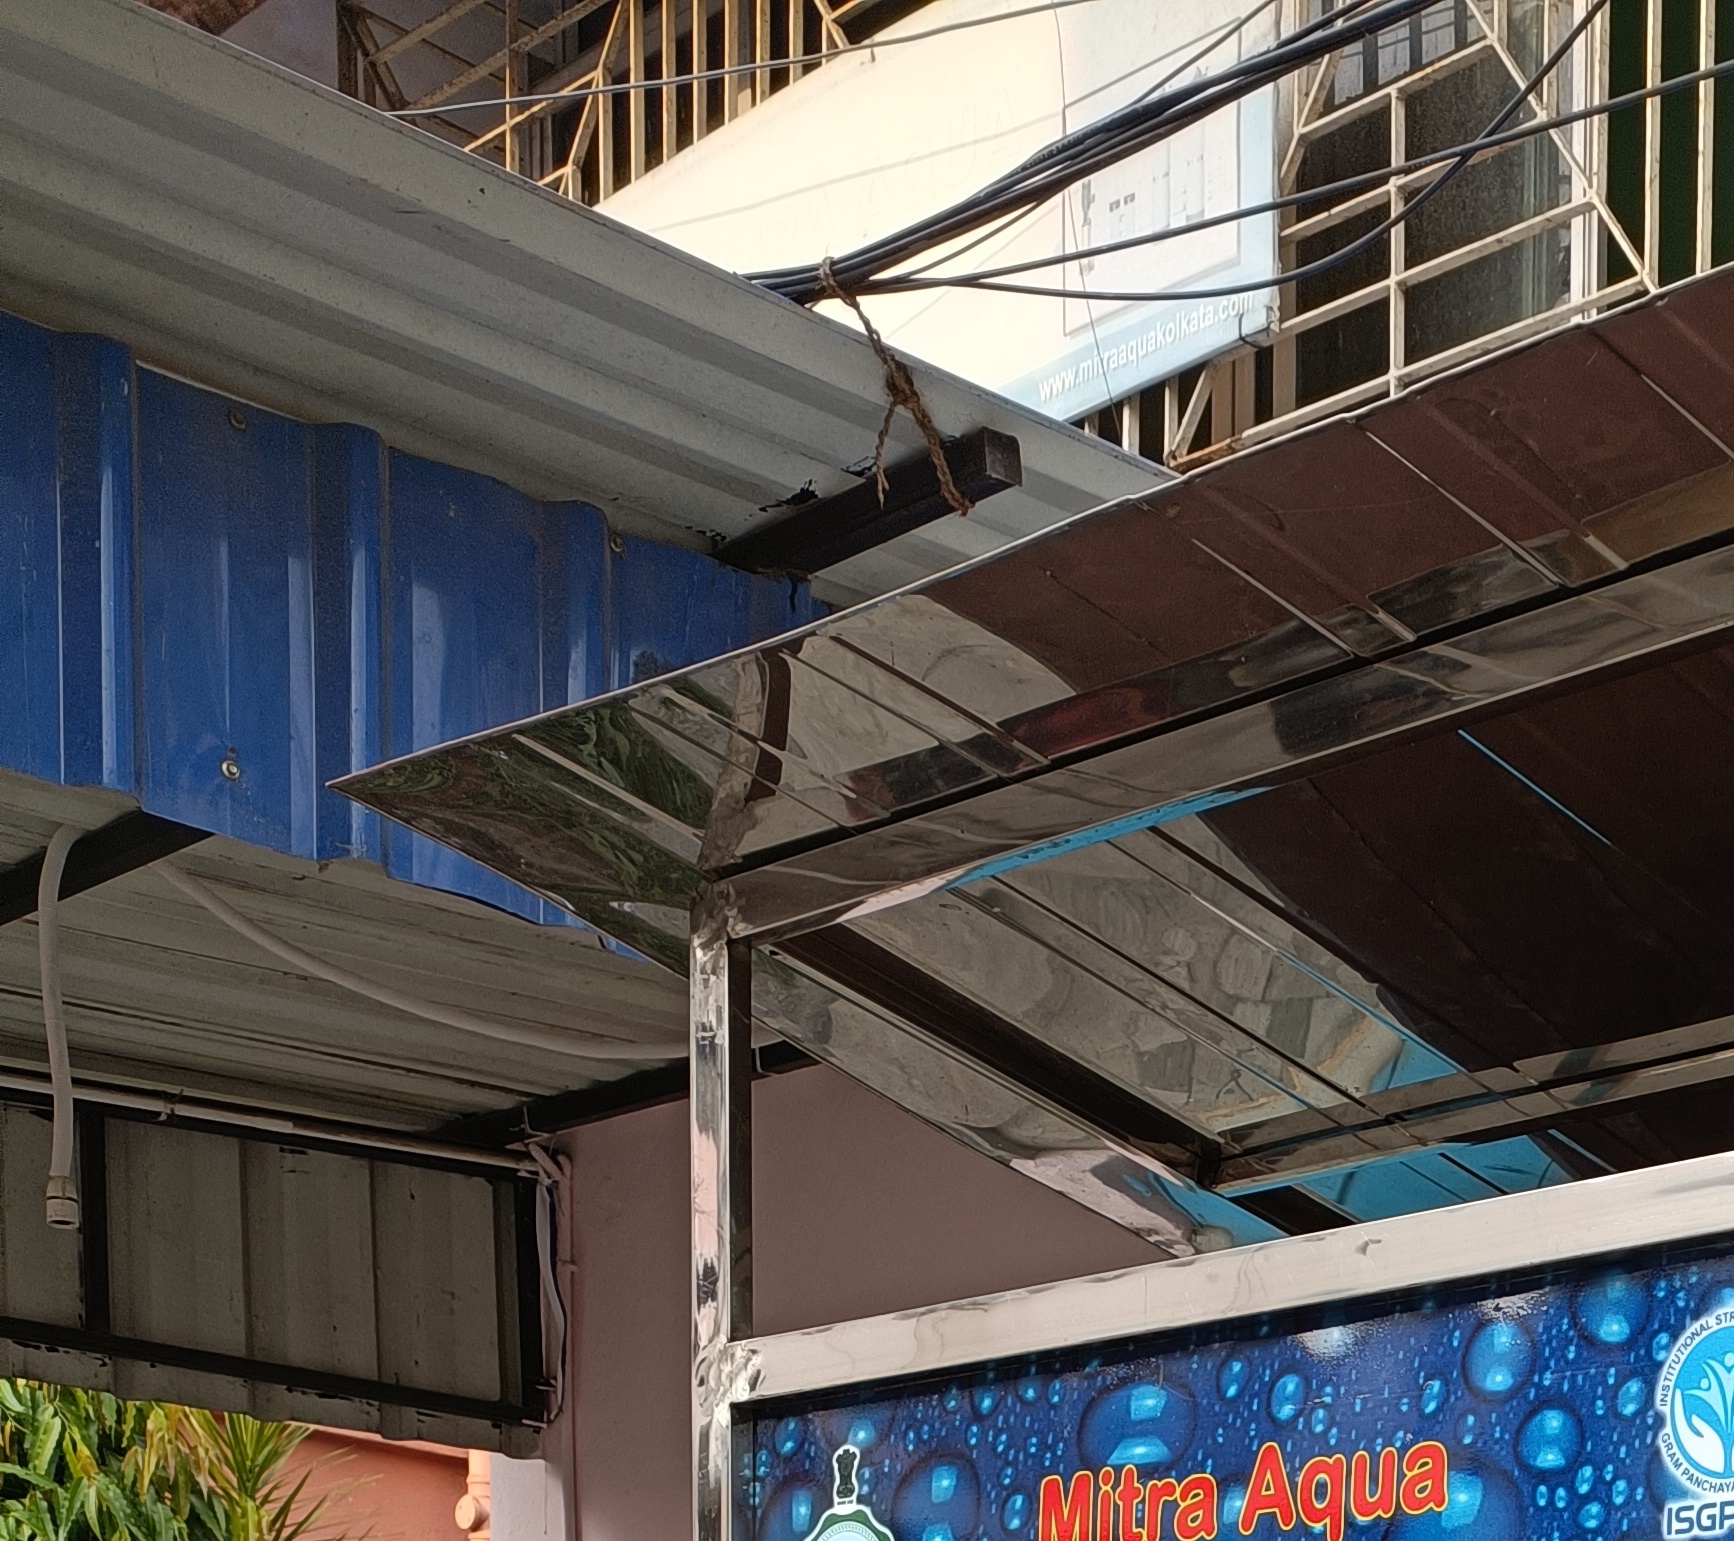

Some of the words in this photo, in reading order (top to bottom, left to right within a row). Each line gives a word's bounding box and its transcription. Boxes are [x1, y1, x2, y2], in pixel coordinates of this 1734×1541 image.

[1038, 290, 1256, 402] www.mitraaquakolkata.com
[1659, 1320, 1714, 1407] INSTITUTIONAL
[1661, 1432, 1683, 1470] GRAM
